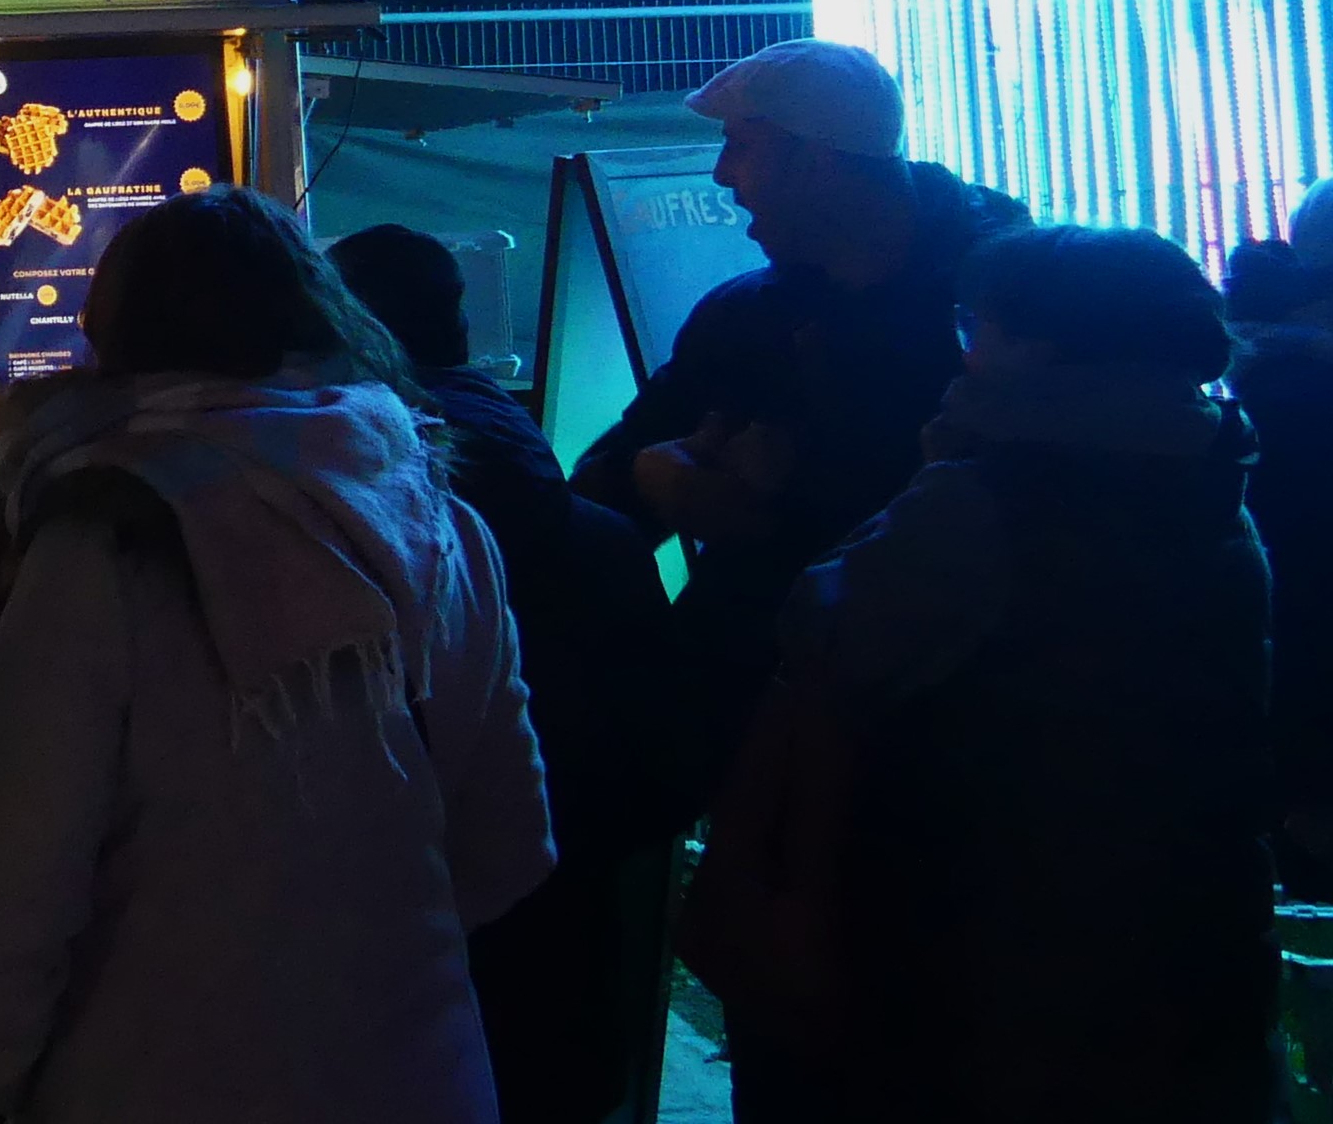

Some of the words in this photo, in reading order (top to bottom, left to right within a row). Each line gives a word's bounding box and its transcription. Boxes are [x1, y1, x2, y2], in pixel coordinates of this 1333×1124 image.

[67, 106, 162, 118] L'AUTHENTIQUE
[67, 187, 82, 196] LA
[0, 292, 34, 300] NUTELLA
